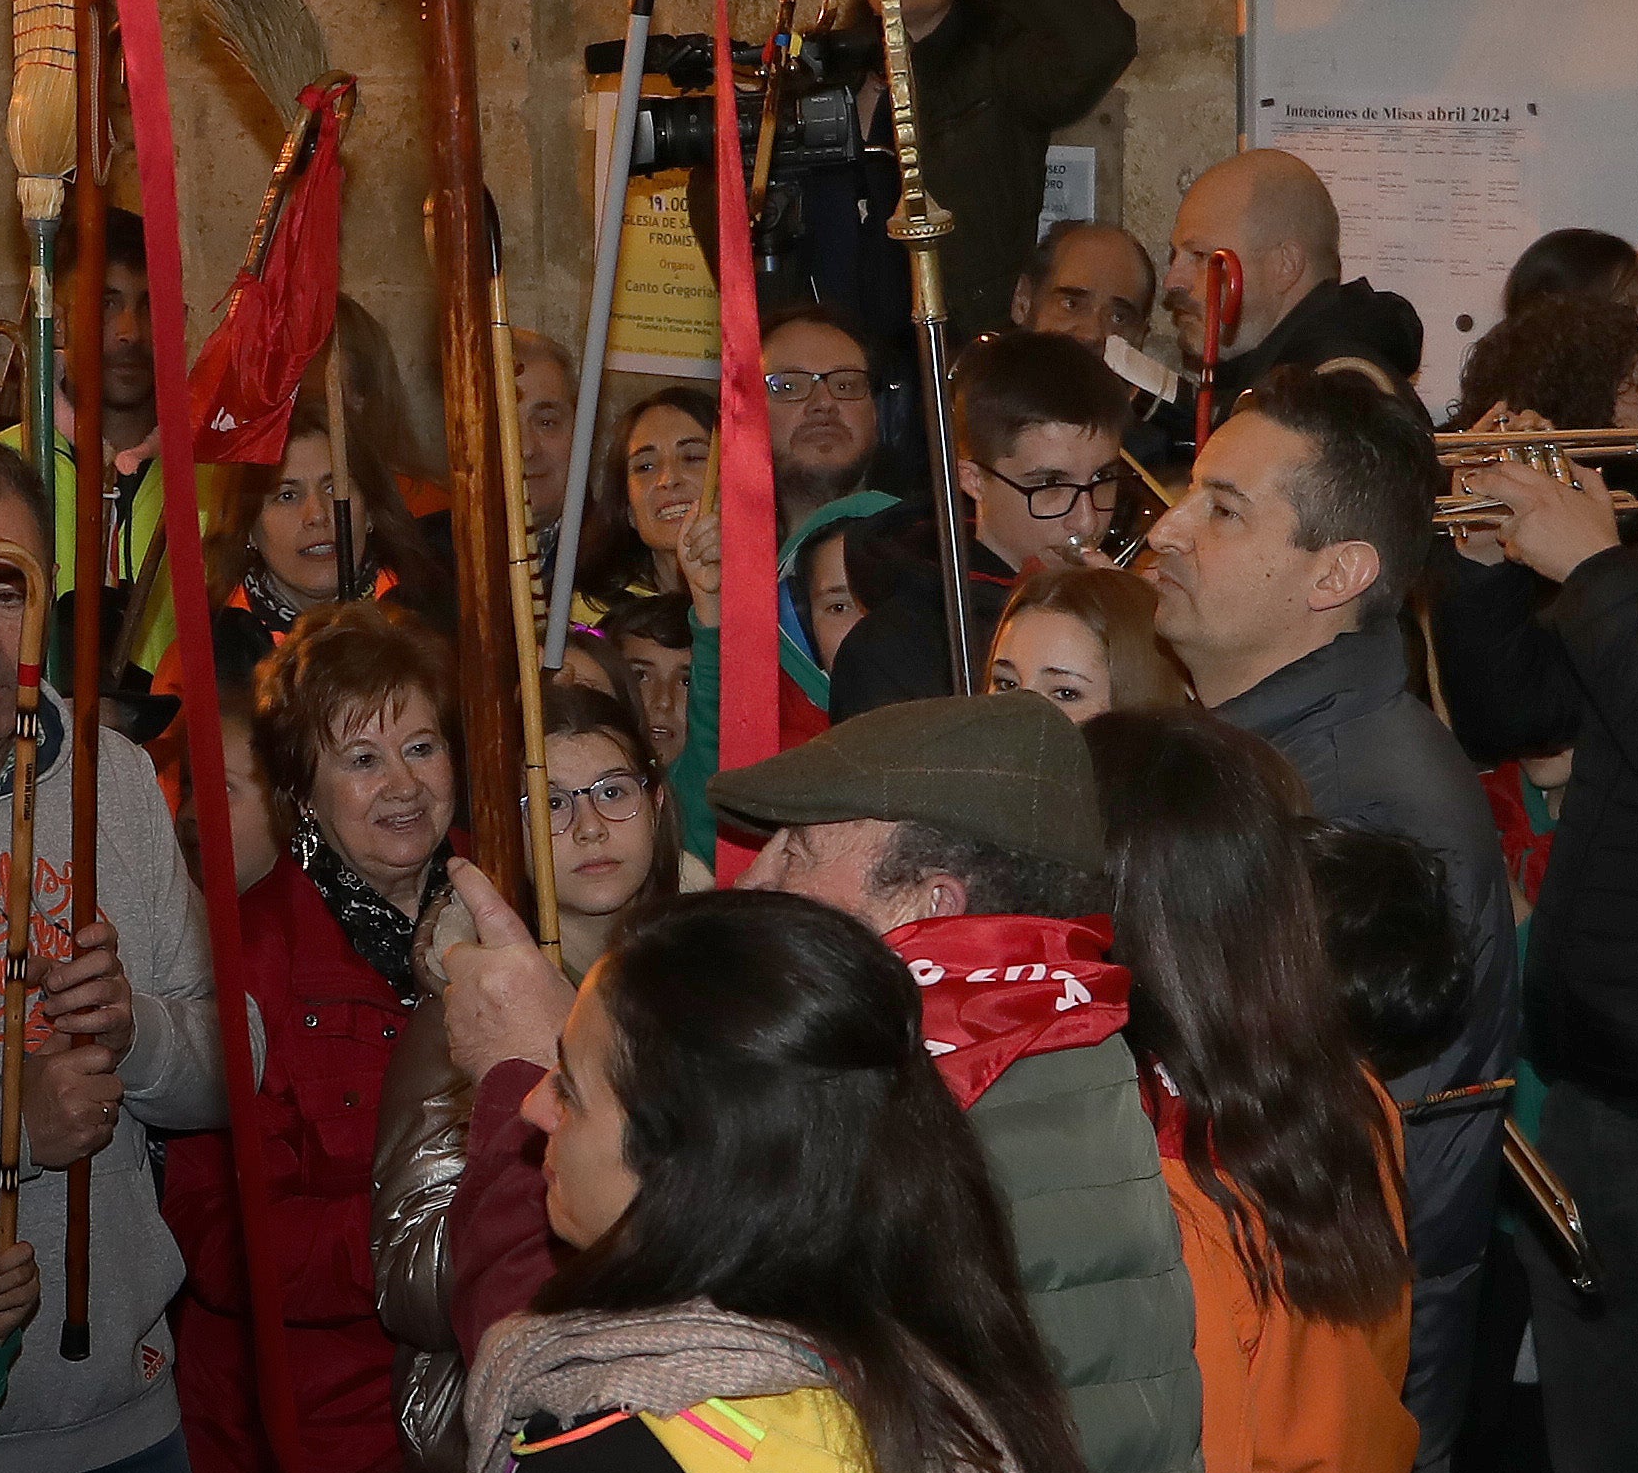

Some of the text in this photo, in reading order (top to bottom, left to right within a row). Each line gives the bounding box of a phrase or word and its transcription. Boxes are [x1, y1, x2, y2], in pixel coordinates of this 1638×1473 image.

[1284, 104, 1511, 123] Intenciones de Misas abril 2024
[624, 279, 659, 294] Canto
